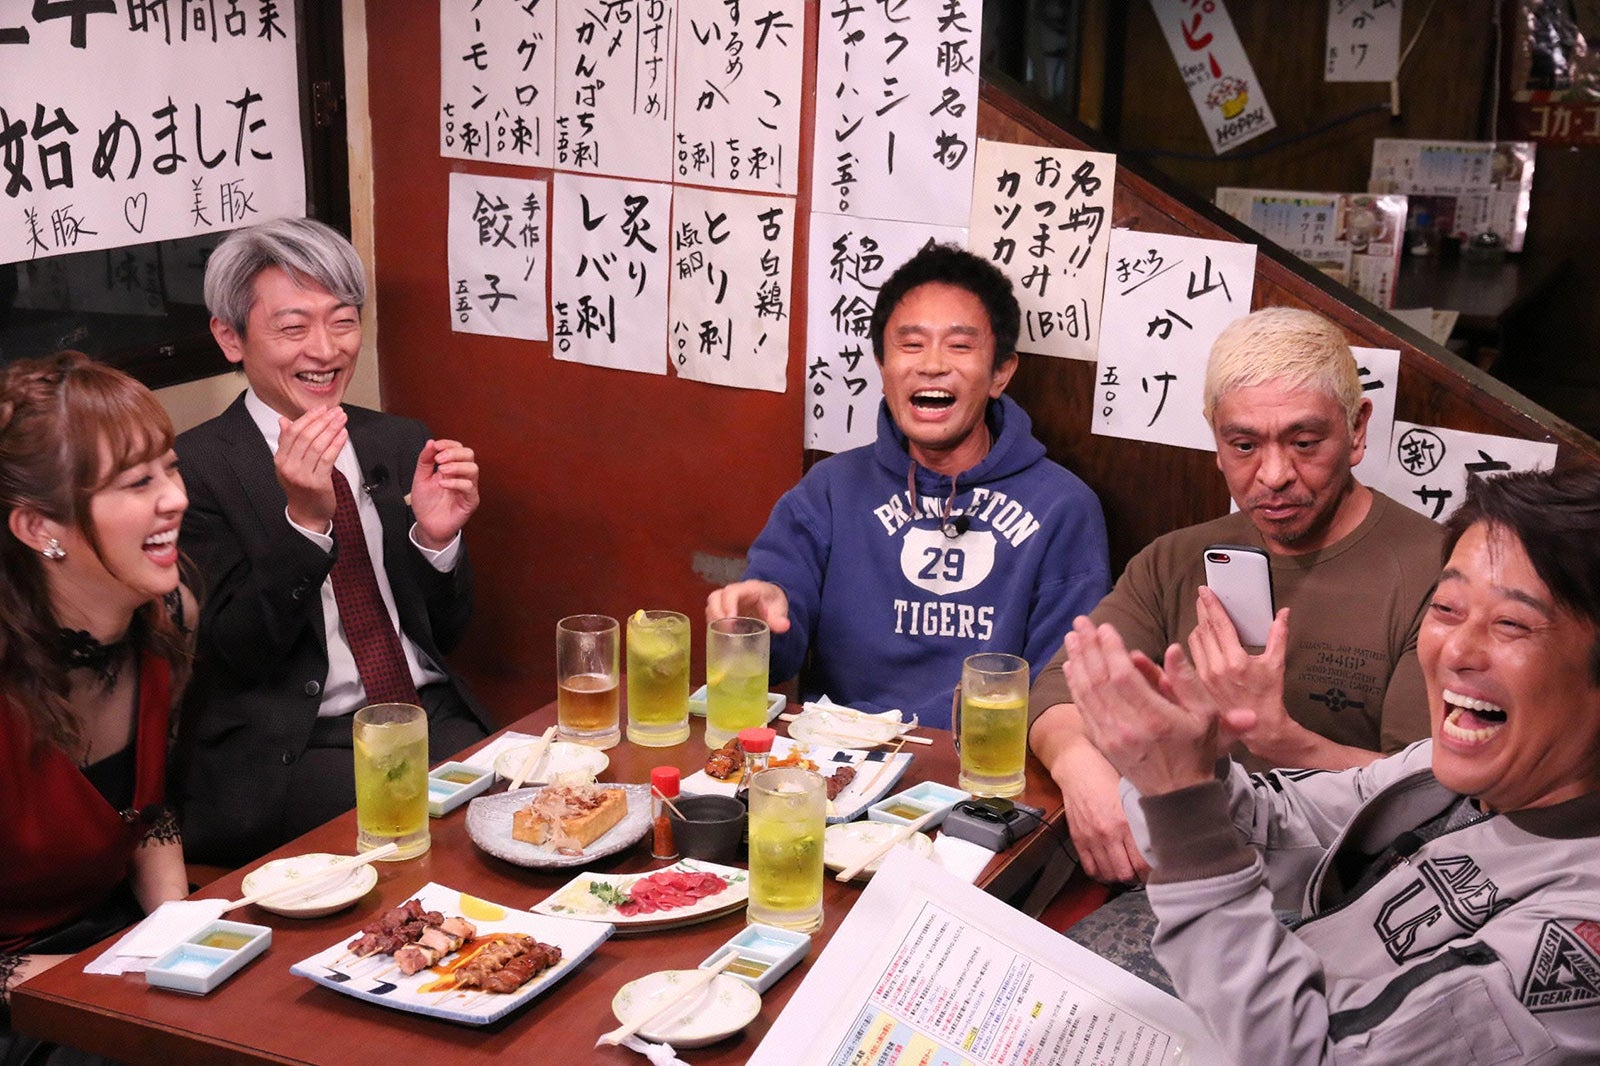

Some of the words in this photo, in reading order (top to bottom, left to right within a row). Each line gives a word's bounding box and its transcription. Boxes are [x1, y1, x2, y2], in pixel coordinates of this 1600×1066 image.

[459, 0, 489, 158] ーモン刺
[572, 9, 607, 168] かんぱち刺
[690, 19, 730, 178] いか刺
[876, 0, 910, 175] セクシー
[0, 88, 273, 198] 始めました
[191, 177, 258, 228] 美豚
[25, 206, 98, 258] 美豚
[472, 190, 518, 312] 餃子
[519, 193, 541, 281] 手作り
[575, 193, 617, 344] レバ刺
[620, 194, 658, 297] 炙り
[698, 210, 733, 362] とり刺
[1021, 156, 1061, 297] おつまみ
[830, 231, 884, 433] 絶倫サワー
[1142, 255, 1232, 428] 山かけ
[874, 487, 1040, 548] PRINCETON
[918, 547, 966, 582] 29
[894, 599, 994, 641] TIGERS
[1540, 989, 1573, 1006] GEAR
